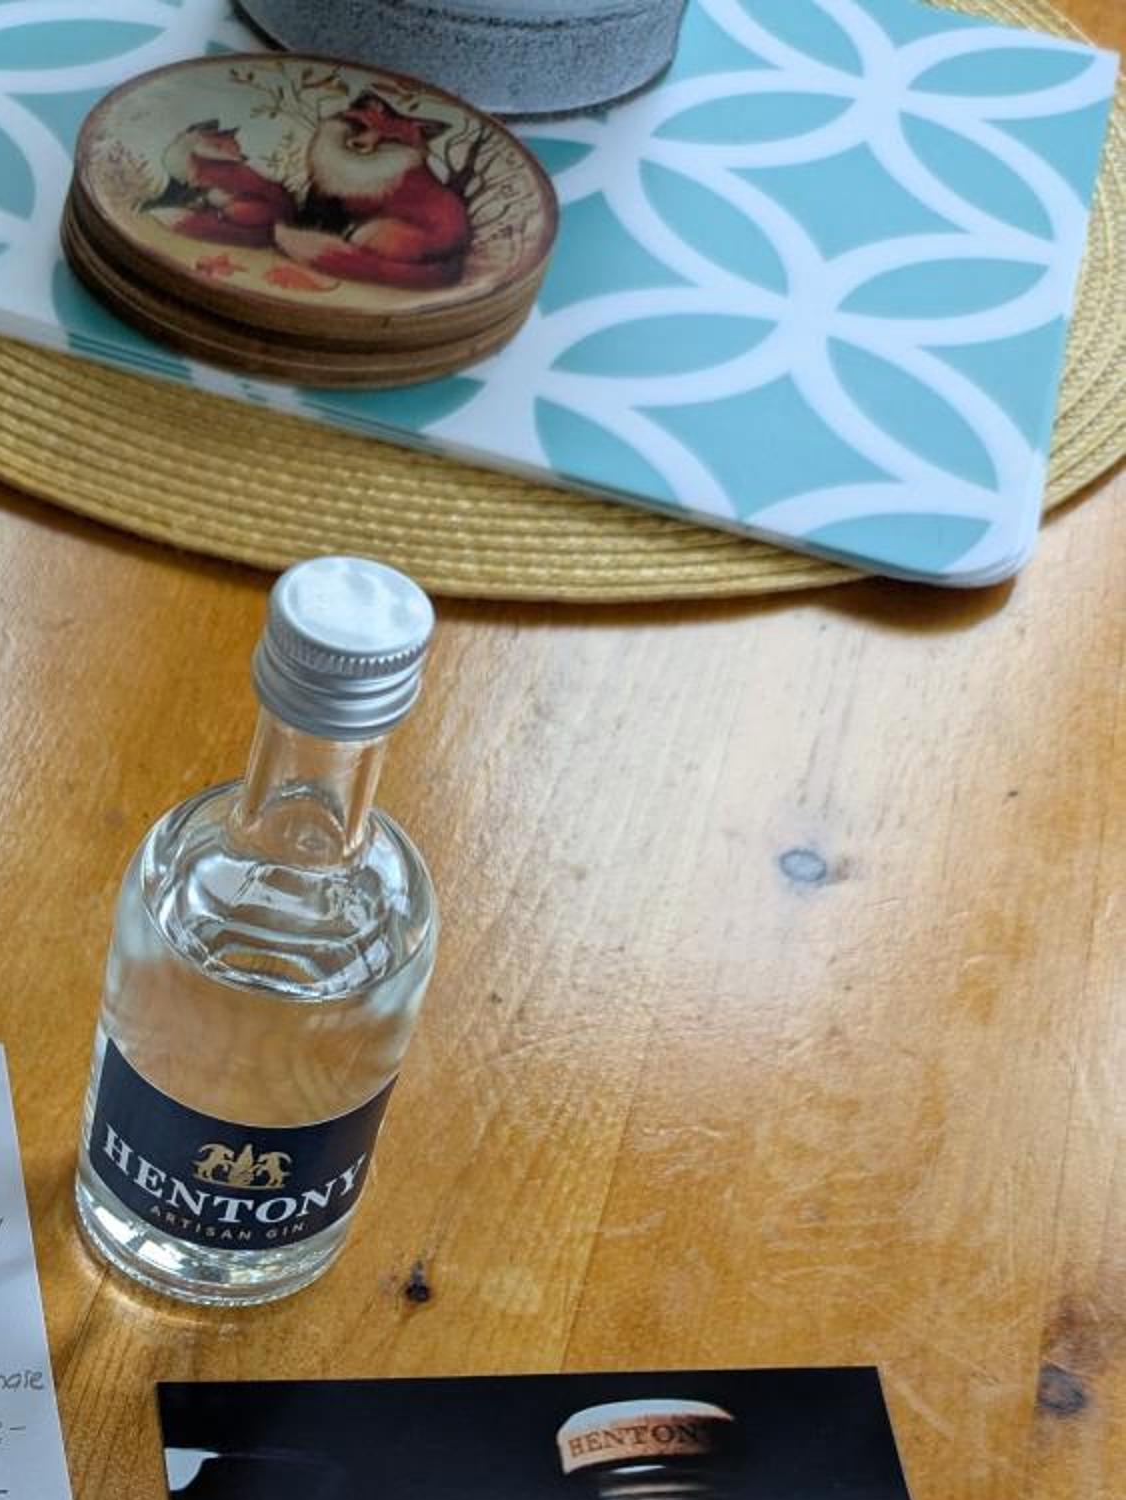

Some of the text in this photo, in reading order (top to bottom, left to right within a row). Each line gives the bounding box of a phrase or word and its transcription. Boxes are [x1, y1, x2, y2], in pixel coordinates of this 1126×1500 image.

[104, 1124, 367, 1223] HENTONY
[150, 1205, 306, 1240] ARTISAN GIN
[568, 1422, 704, 1457] HENTON
